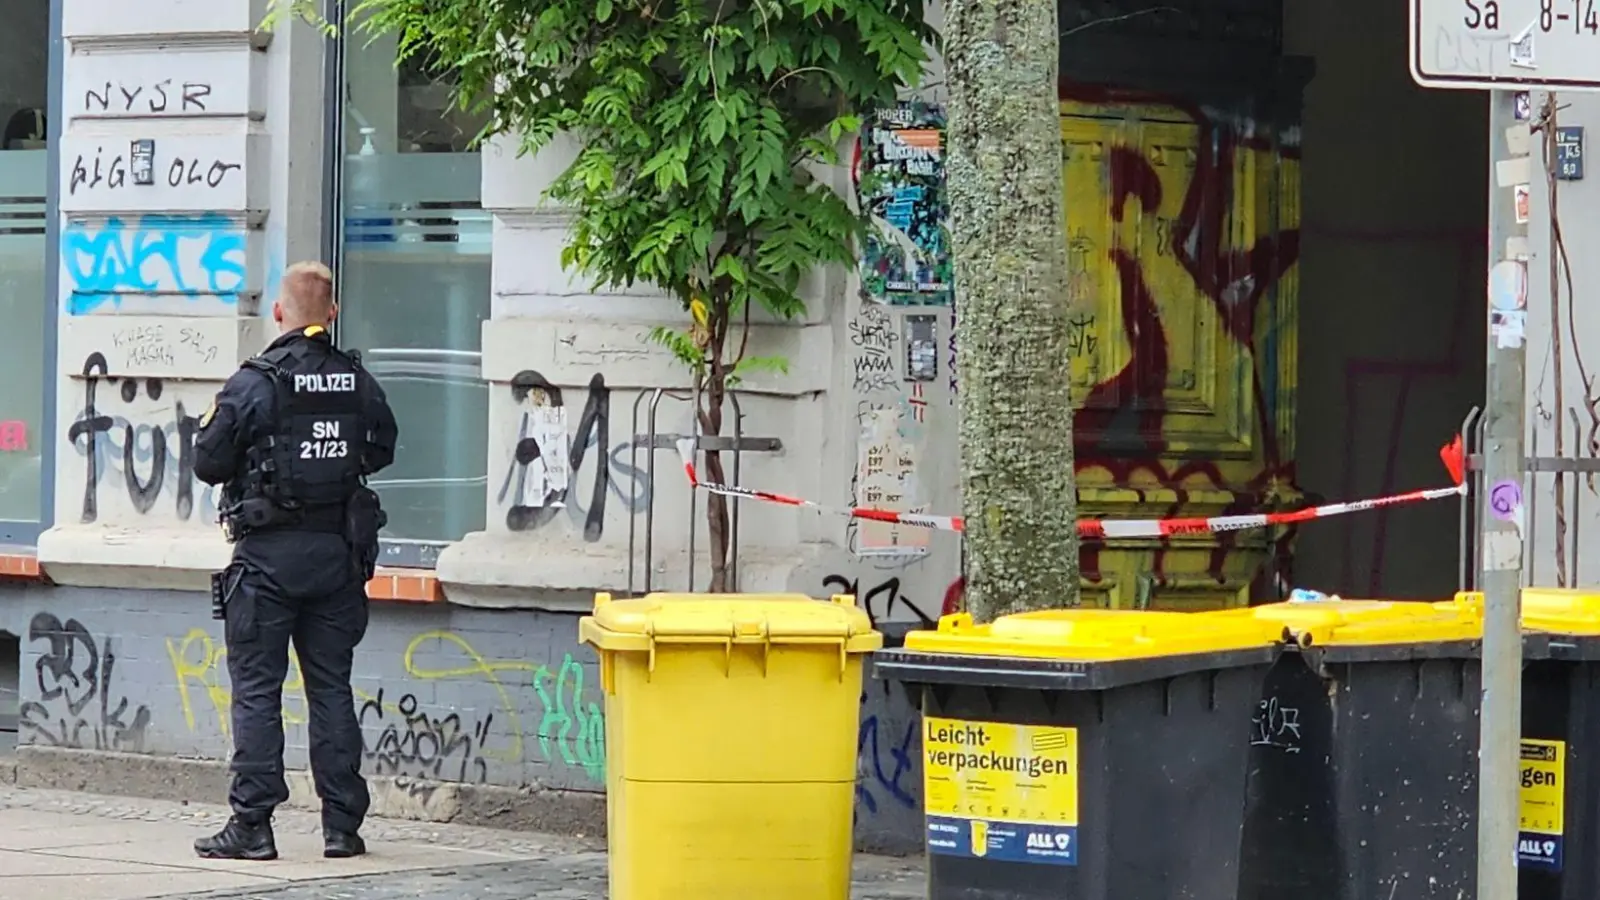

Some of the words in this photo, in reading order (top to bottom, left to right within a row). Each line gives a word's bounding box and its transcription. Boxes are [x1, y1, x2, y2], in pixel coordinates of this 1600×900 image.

[1465, 0, 1499, 30] Sa
[294, 373, 355, 392] POLIZEI
[312, 421, 340, 438] SN
[300, 441, 348, 458] 21/23
[928, 722, 990, 746] Leicht-
[928, 749, 1068, 778] verpackungen
[1027, 832, 1055, 849] ALL
[1519, 840, 1543, 855] ALL
